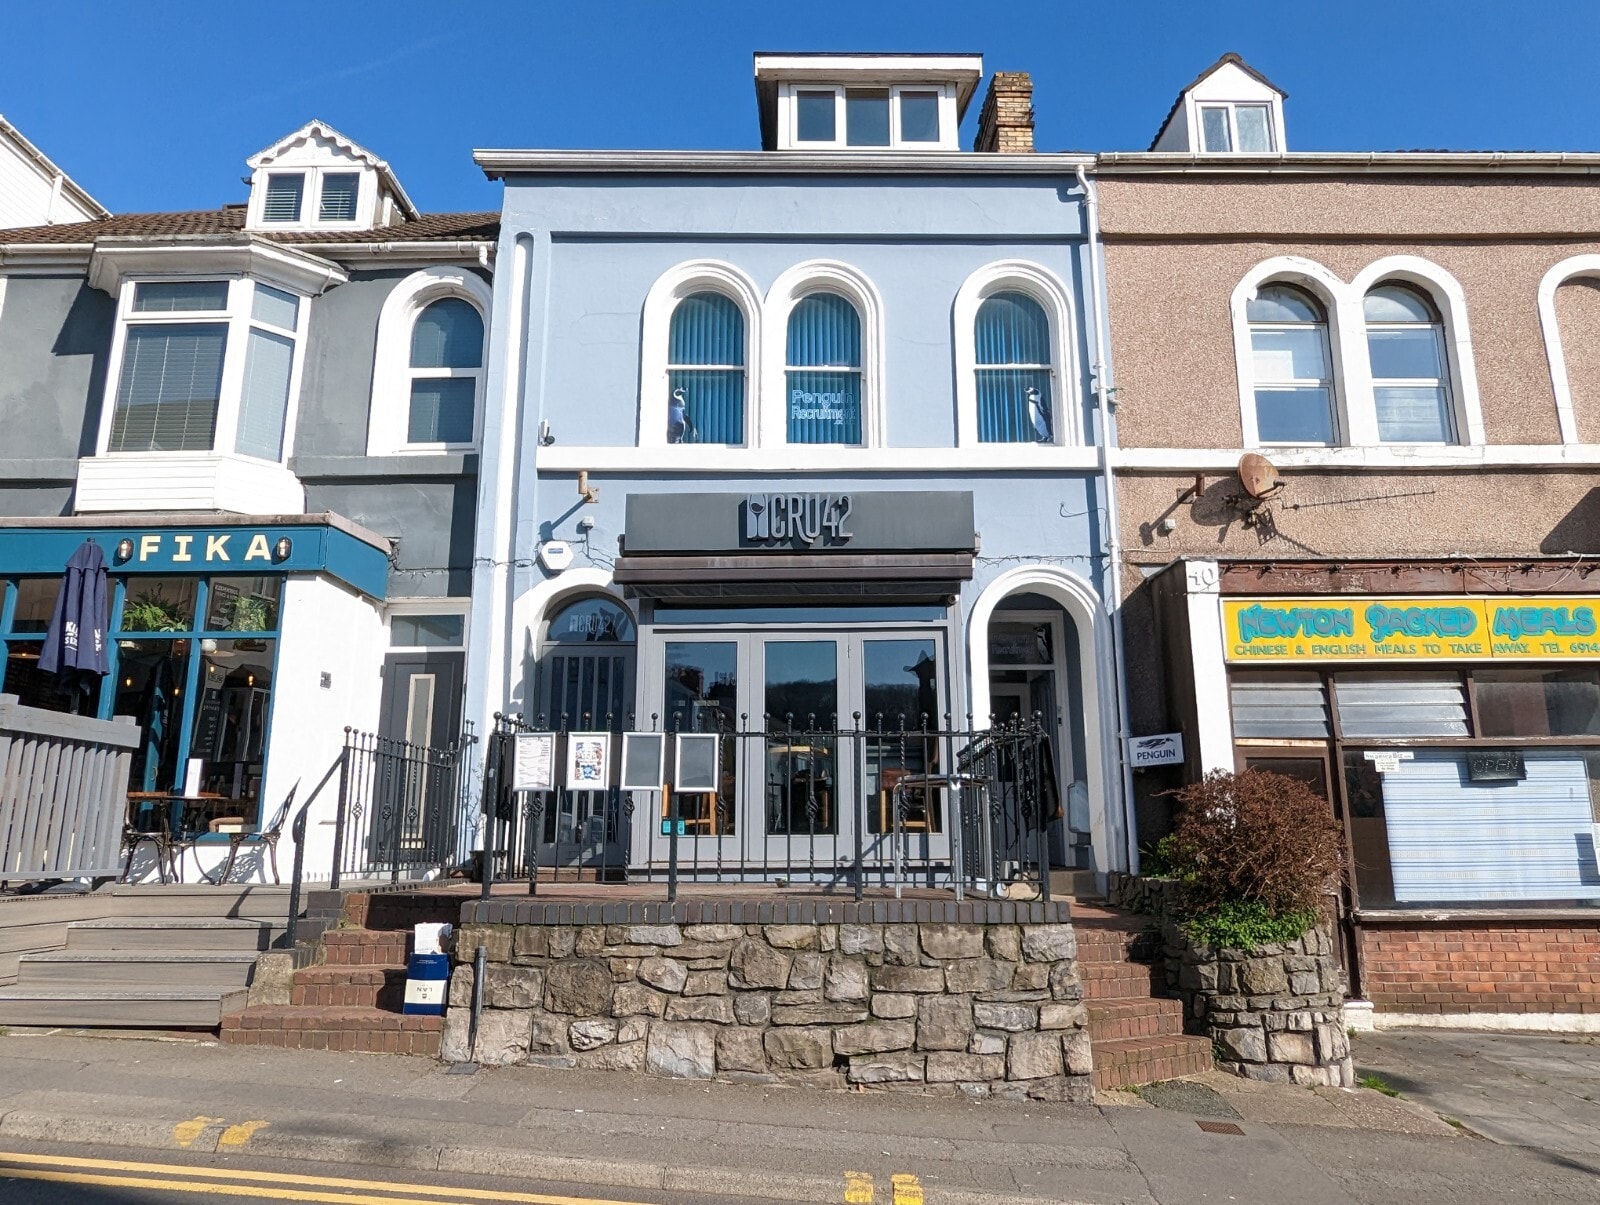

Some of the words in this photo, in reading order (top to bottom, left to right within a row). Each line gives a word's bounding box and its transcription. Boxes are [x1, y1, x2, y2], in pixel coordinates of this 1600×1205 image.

[792, 390, 855, 409] Penguin
[139, 534, 272, 562] FIKA
[1238, 604, 1354, 643] NEWTON
[1365, 604, 1478, 643] PACKED
[1492, 606, 1597, 641] MEALS
[1234, 644, 1288, 656] CHINESE
[1295, 644, 1306, 655] &
[1311, 644, 1367, 655] ENGLISH
[1374, 643, 1417, 655] MEALS
[1423, 643, 1441, 654] TO
[1448, 643, 1483, 654] TAKE
[1136, 748, 1176, 760] PENGUIN
[1472, 757, 1519, 773] OPEN
